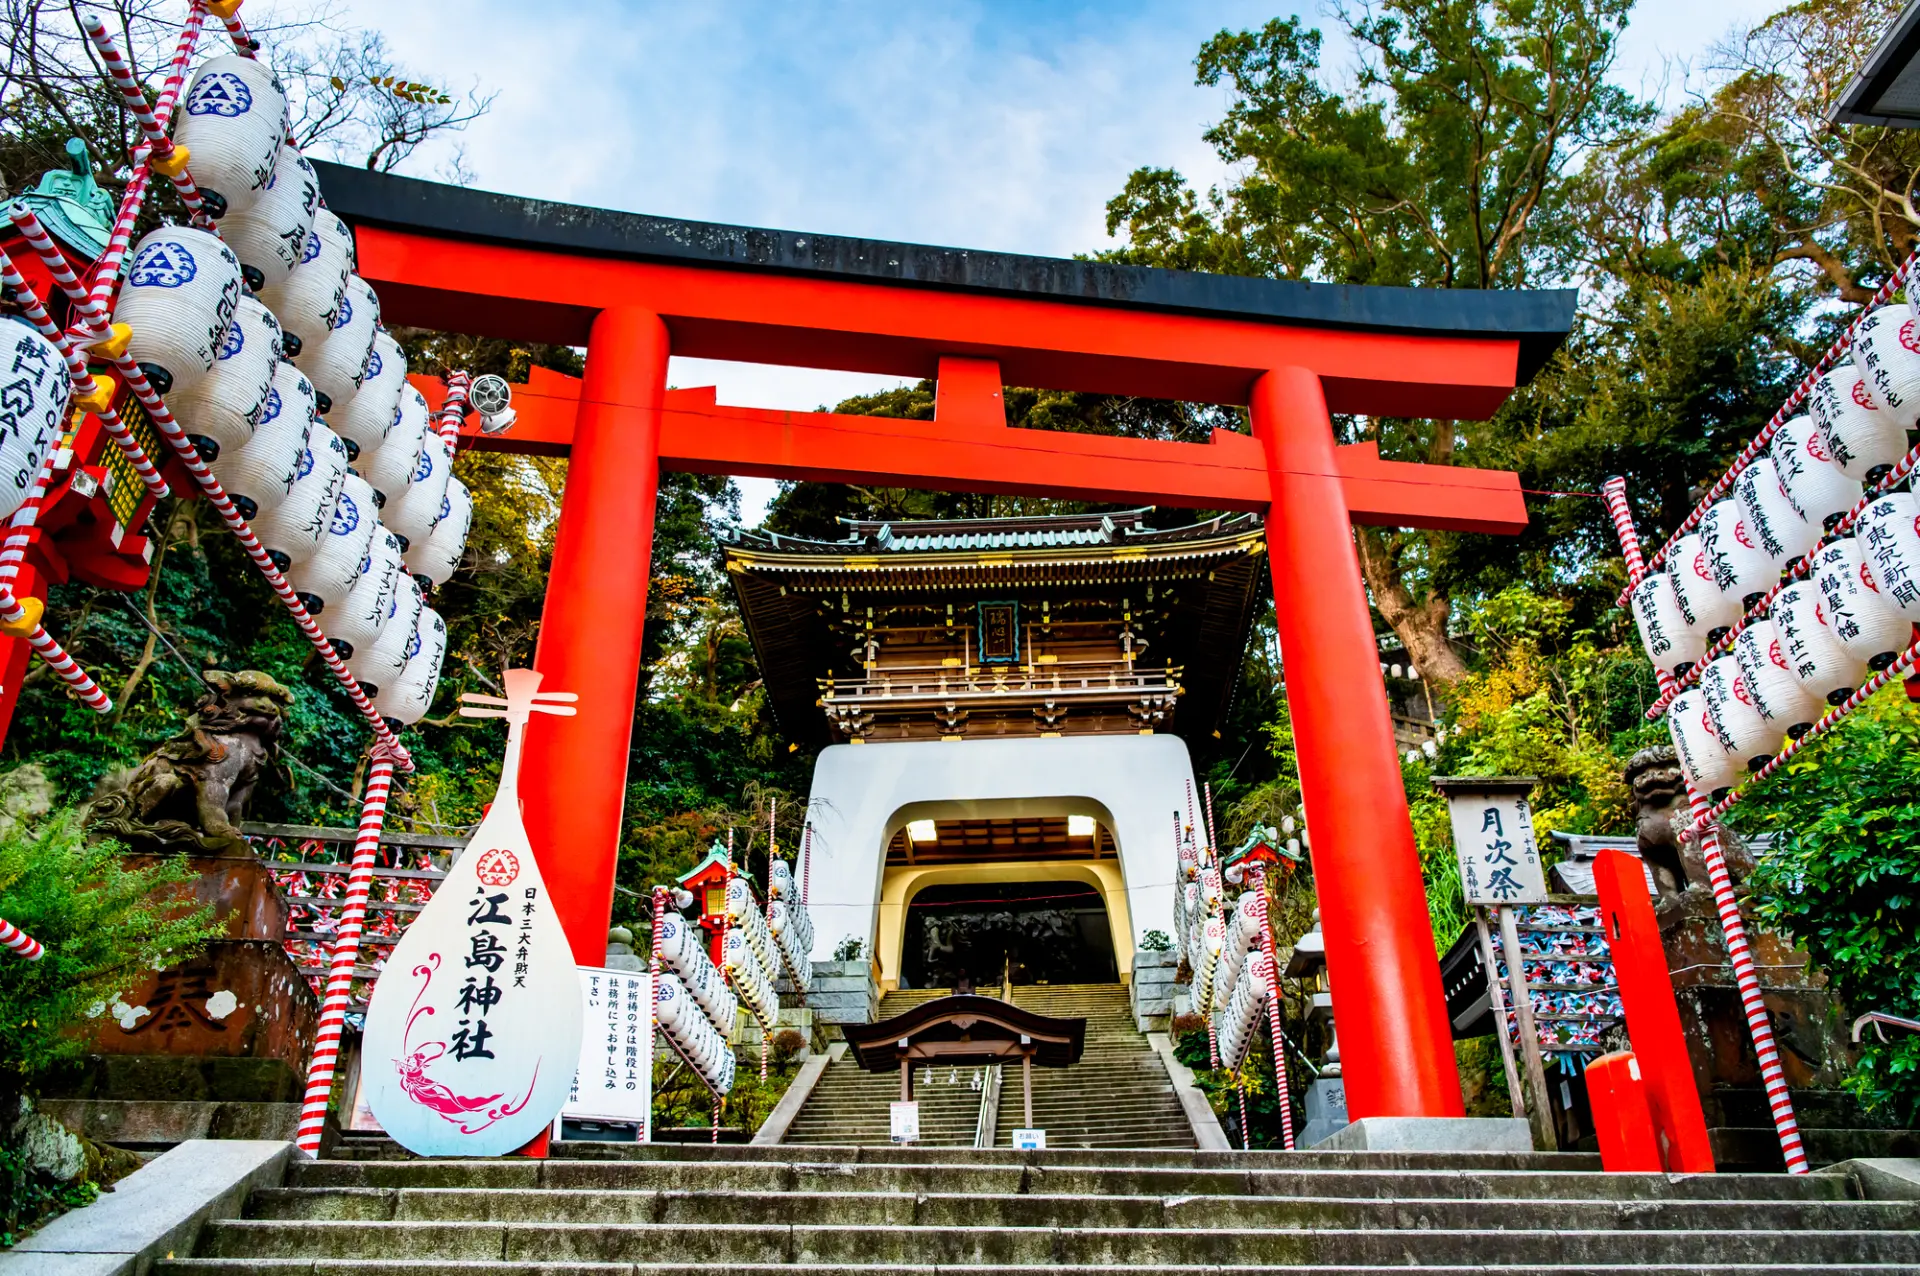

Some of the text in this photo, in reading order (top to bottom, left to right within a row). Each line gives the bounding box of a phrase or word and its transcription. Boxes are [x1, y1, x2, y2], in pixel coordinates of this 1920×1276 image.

[1820, 573, 1860, 642] 鶴屋八幡
[1866, 523, 1920, 609] 東京新聞
[1462, 855, 1482, 899] 江島神社
[1479, 806, 1524, 901] 月次祭
[447, 885, 513, 1063] 江島神社
[512, 887, 538, 989] 日本三大弁財天
[589, 975, 600, 1007] 下さい
[604, 977, 620, 1090] 社務所にてお申し込み
[624, 978, 640, 1092] 御祈祷の方は階段上の
